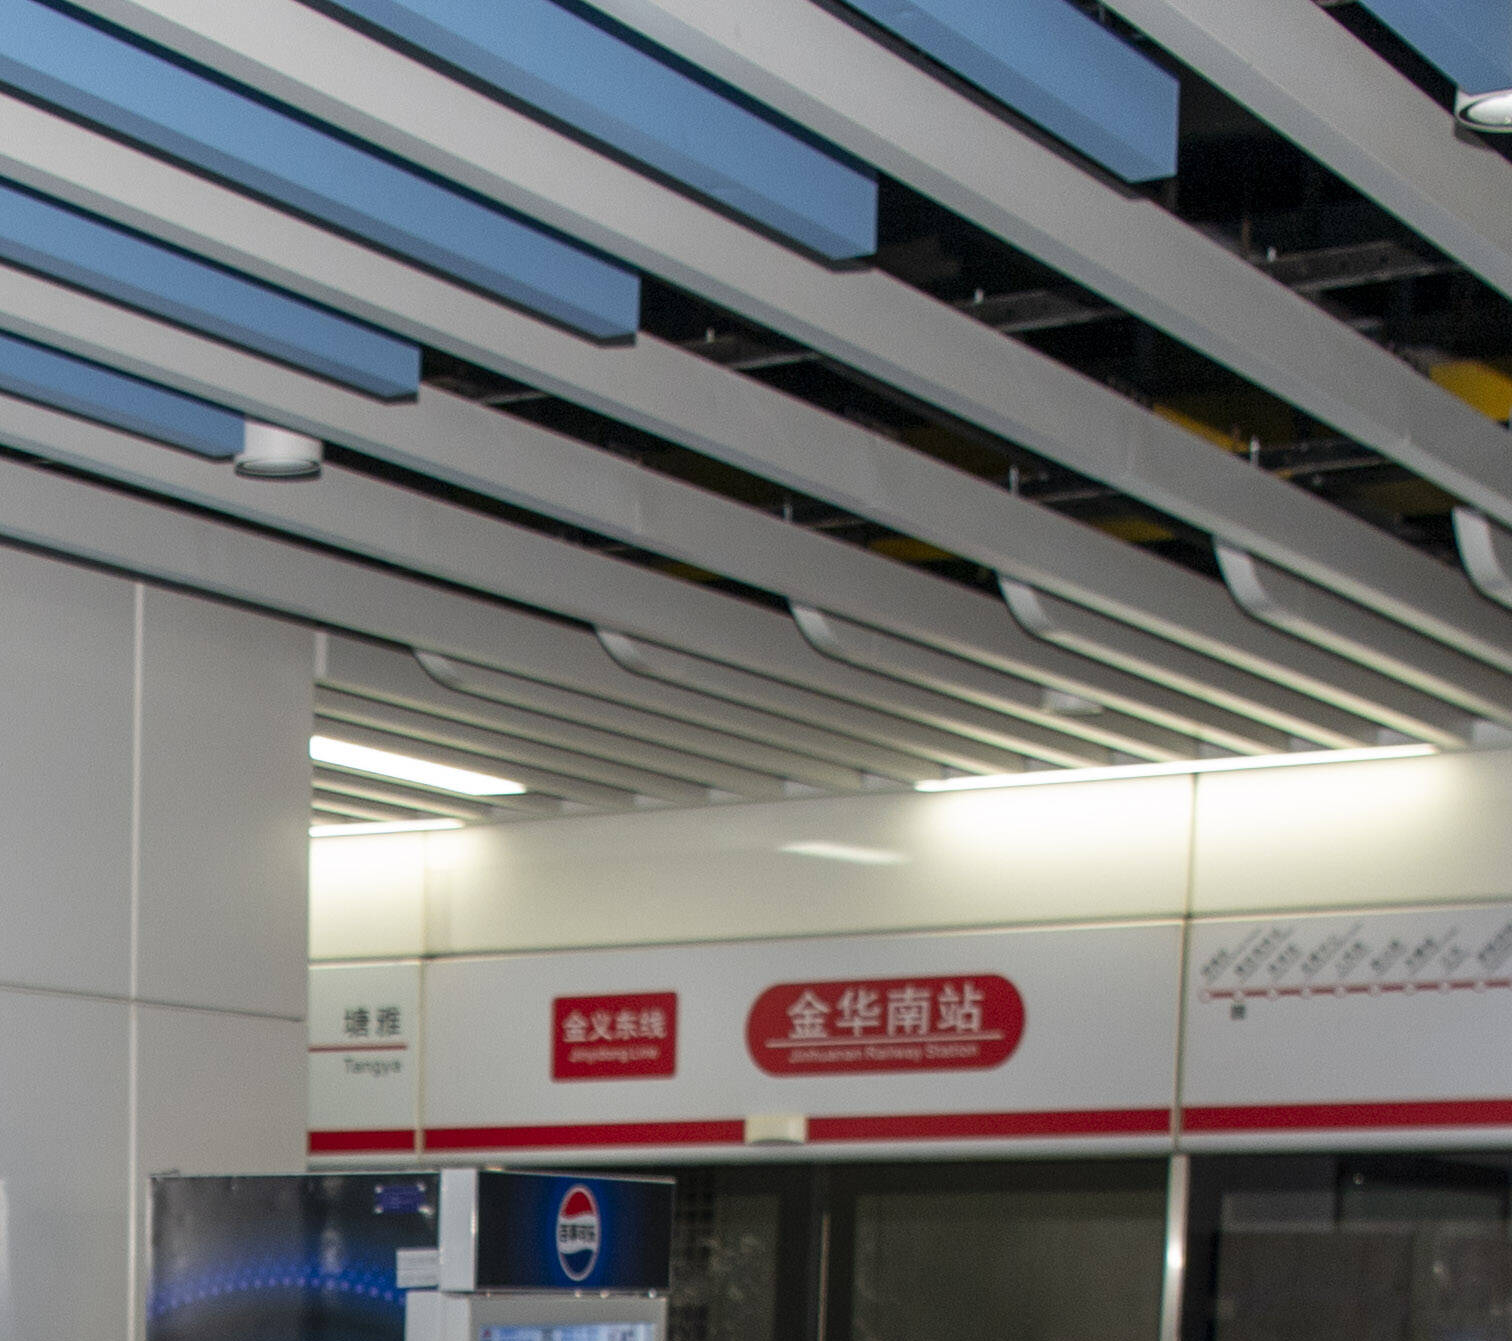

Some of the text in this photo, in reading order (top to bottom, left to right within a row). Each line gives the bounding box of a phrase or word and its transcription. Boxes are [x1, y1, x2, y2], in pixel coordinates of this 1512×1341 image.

[562, 1008, 668, 1043] 金义东线
[786, 980, 984, 1040] 金华南站
